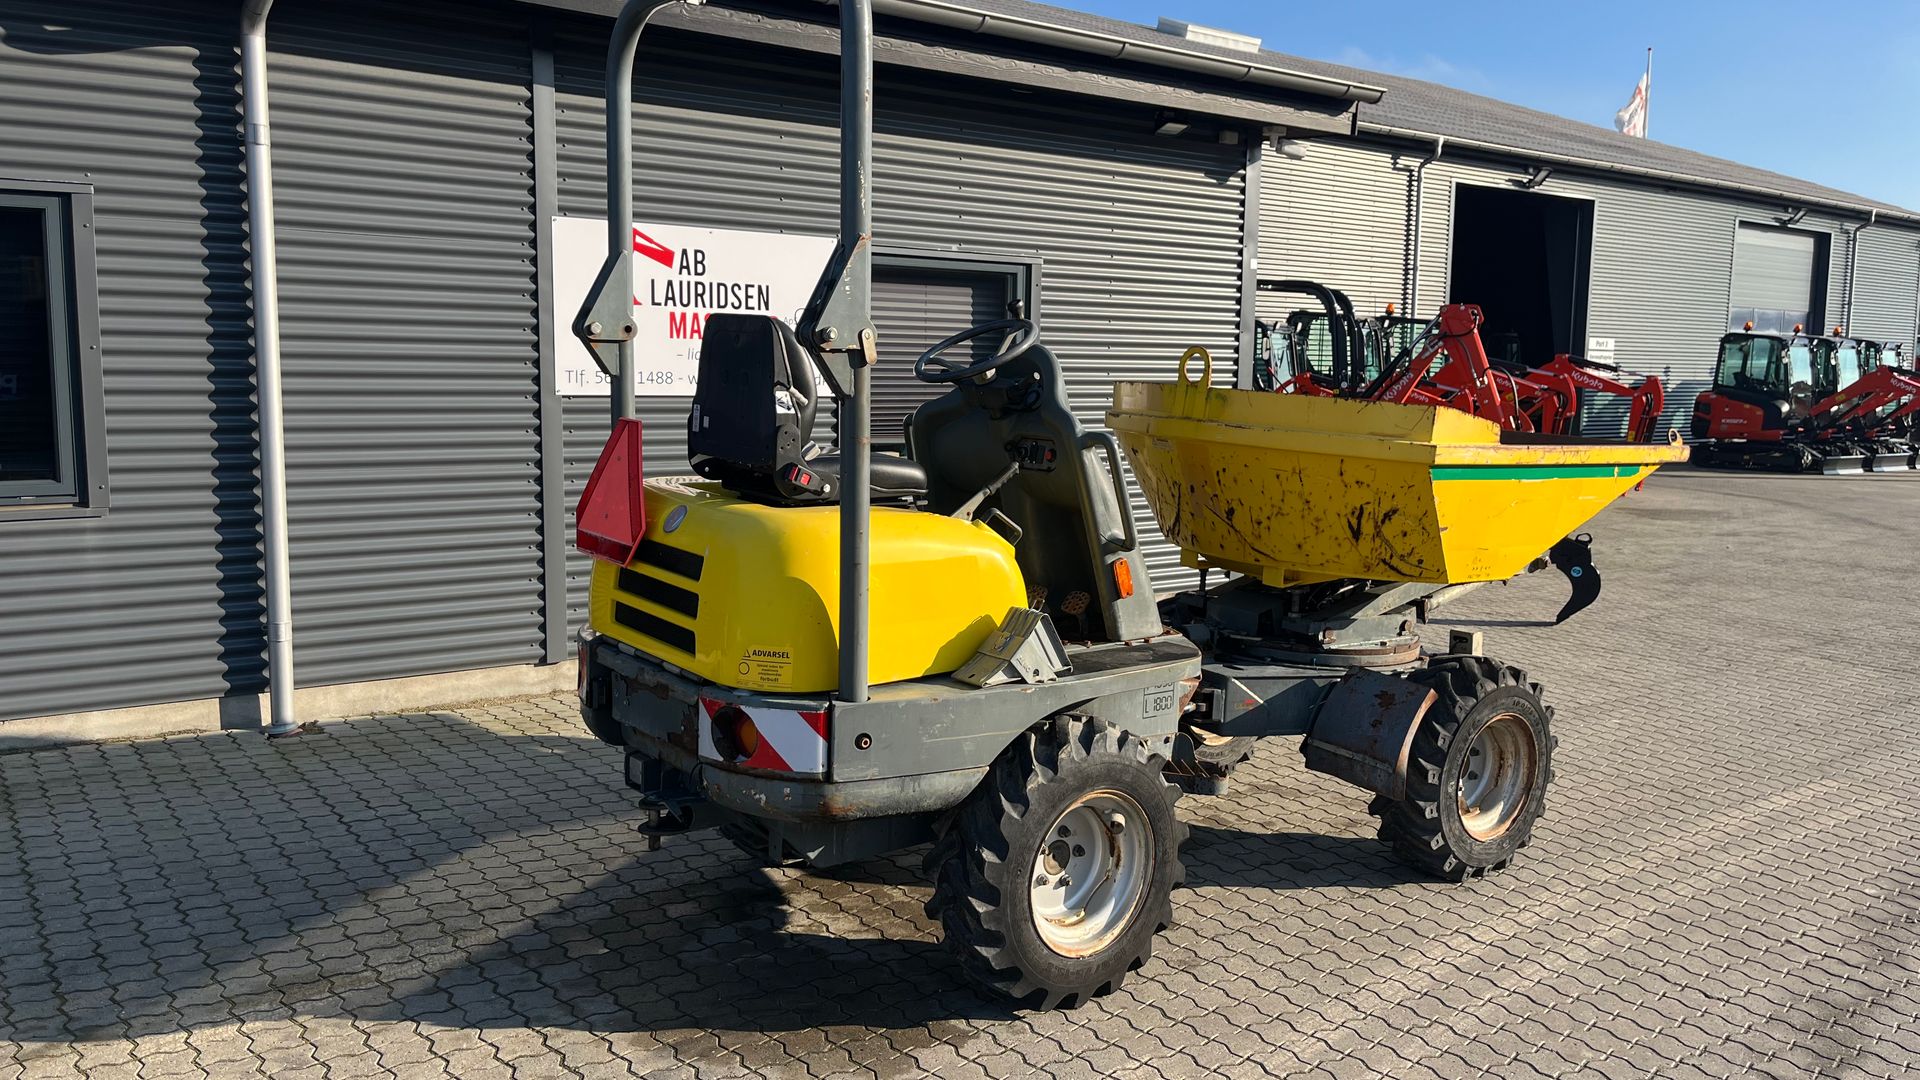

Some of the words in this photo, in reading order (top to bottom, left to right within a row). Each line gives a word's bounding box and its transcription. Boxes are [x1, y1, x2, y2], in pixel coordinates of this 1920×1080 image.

[679, 248, 706, 276] AB
[651, 279, 769, 311] LAURIDSEN
[565, 370, 589, 387] Tlf.
[638, 371, 673, 385] 1488
[1379, 372, 1414, 400] Kubota
[1571, 370, 1604, 389] Kubota
[752, 649, 790, 659] ADVARSEL
[1153, 695, 1172, 712] 1800
